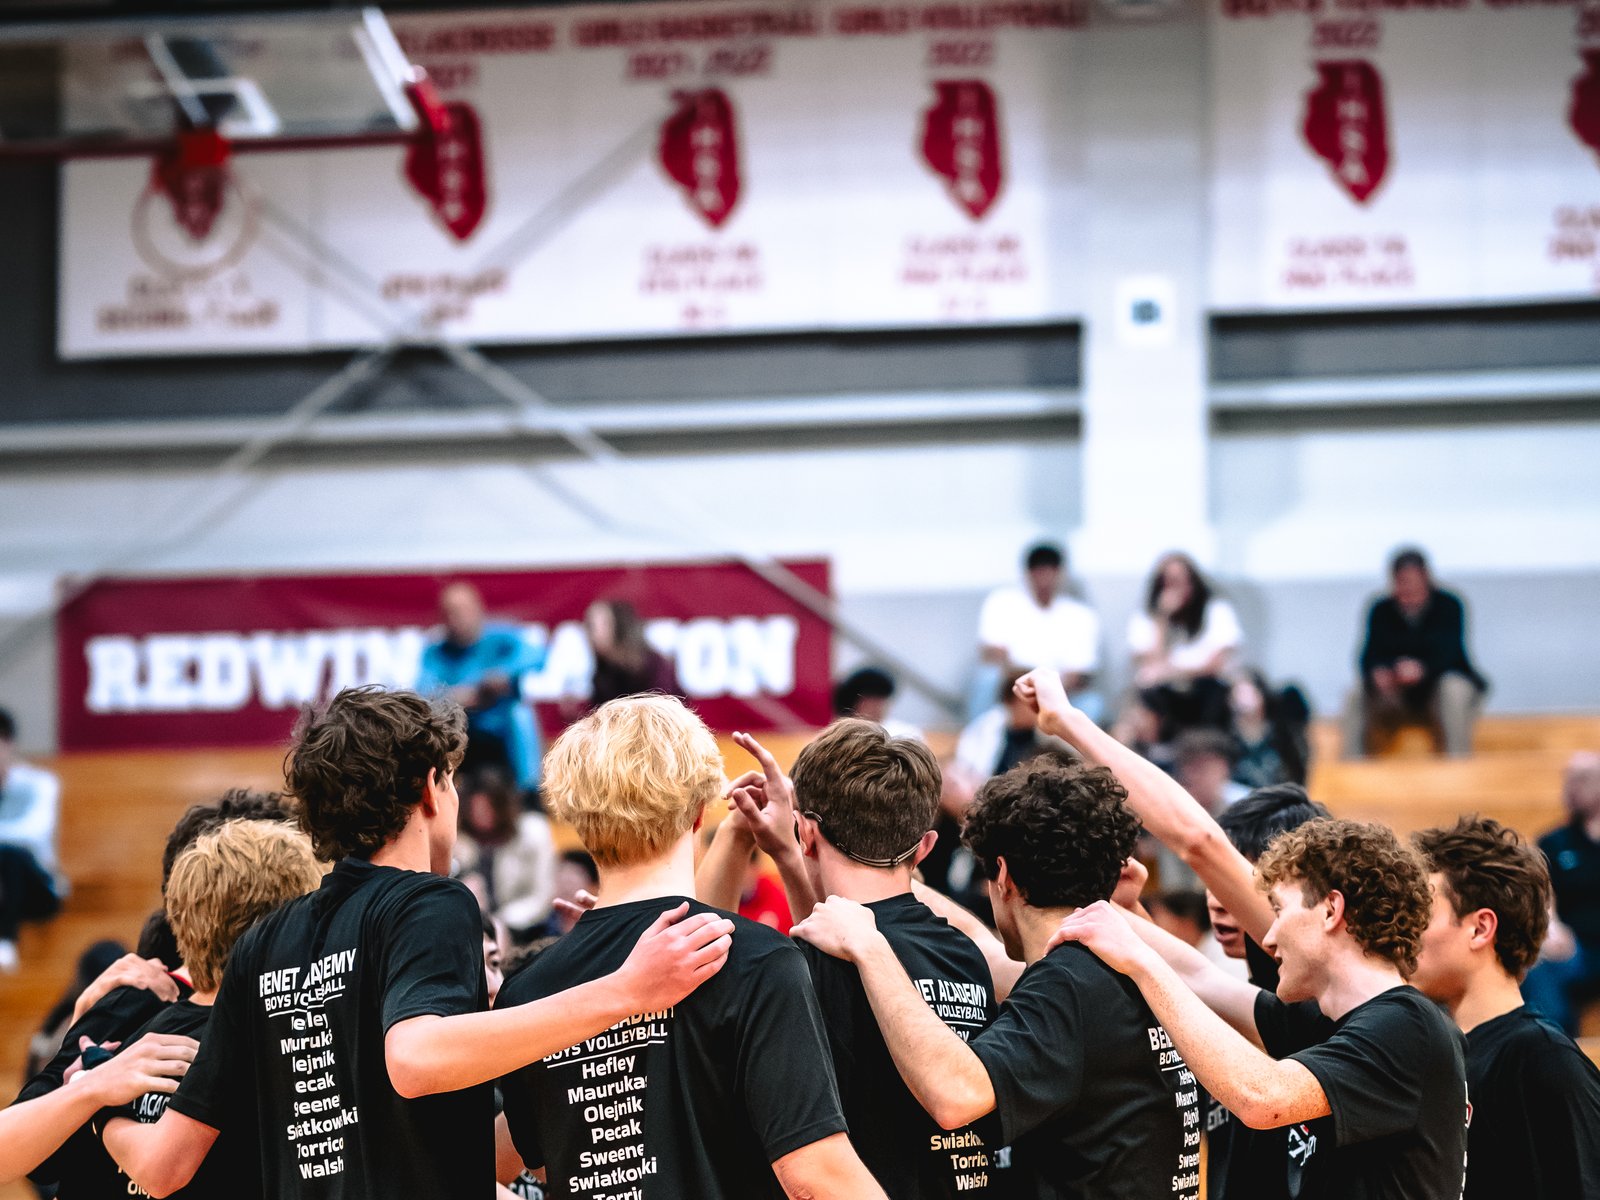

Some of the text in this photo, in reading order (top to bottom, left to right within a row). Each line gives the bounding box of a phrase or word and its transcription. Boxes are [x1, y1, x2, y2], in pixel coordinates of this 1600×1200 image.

[86, 627, 424, 712] REDWIN
[264, 993, 292, 1012] BOYS
[938, 979, 987, 1008] ACADEMY
[937, 1003, 987, 1021] VOLLEYBALL
[292, 1050, 336, 1075] lejnik
[582, 1055, 636, 1080] Hefley
[295, 1072, 336, 1094] ecak
[567, 1075, 648, 1105] Mauruka
[583, 1095, 644, 1122] Olejnik
[591, 1118, 643, 1145] Pecak
[299, 1156, 344, 1180] Walsh
[579, 1143, 645, 1169] Sweene
[955, 1171, 988, 1191] Walsh
